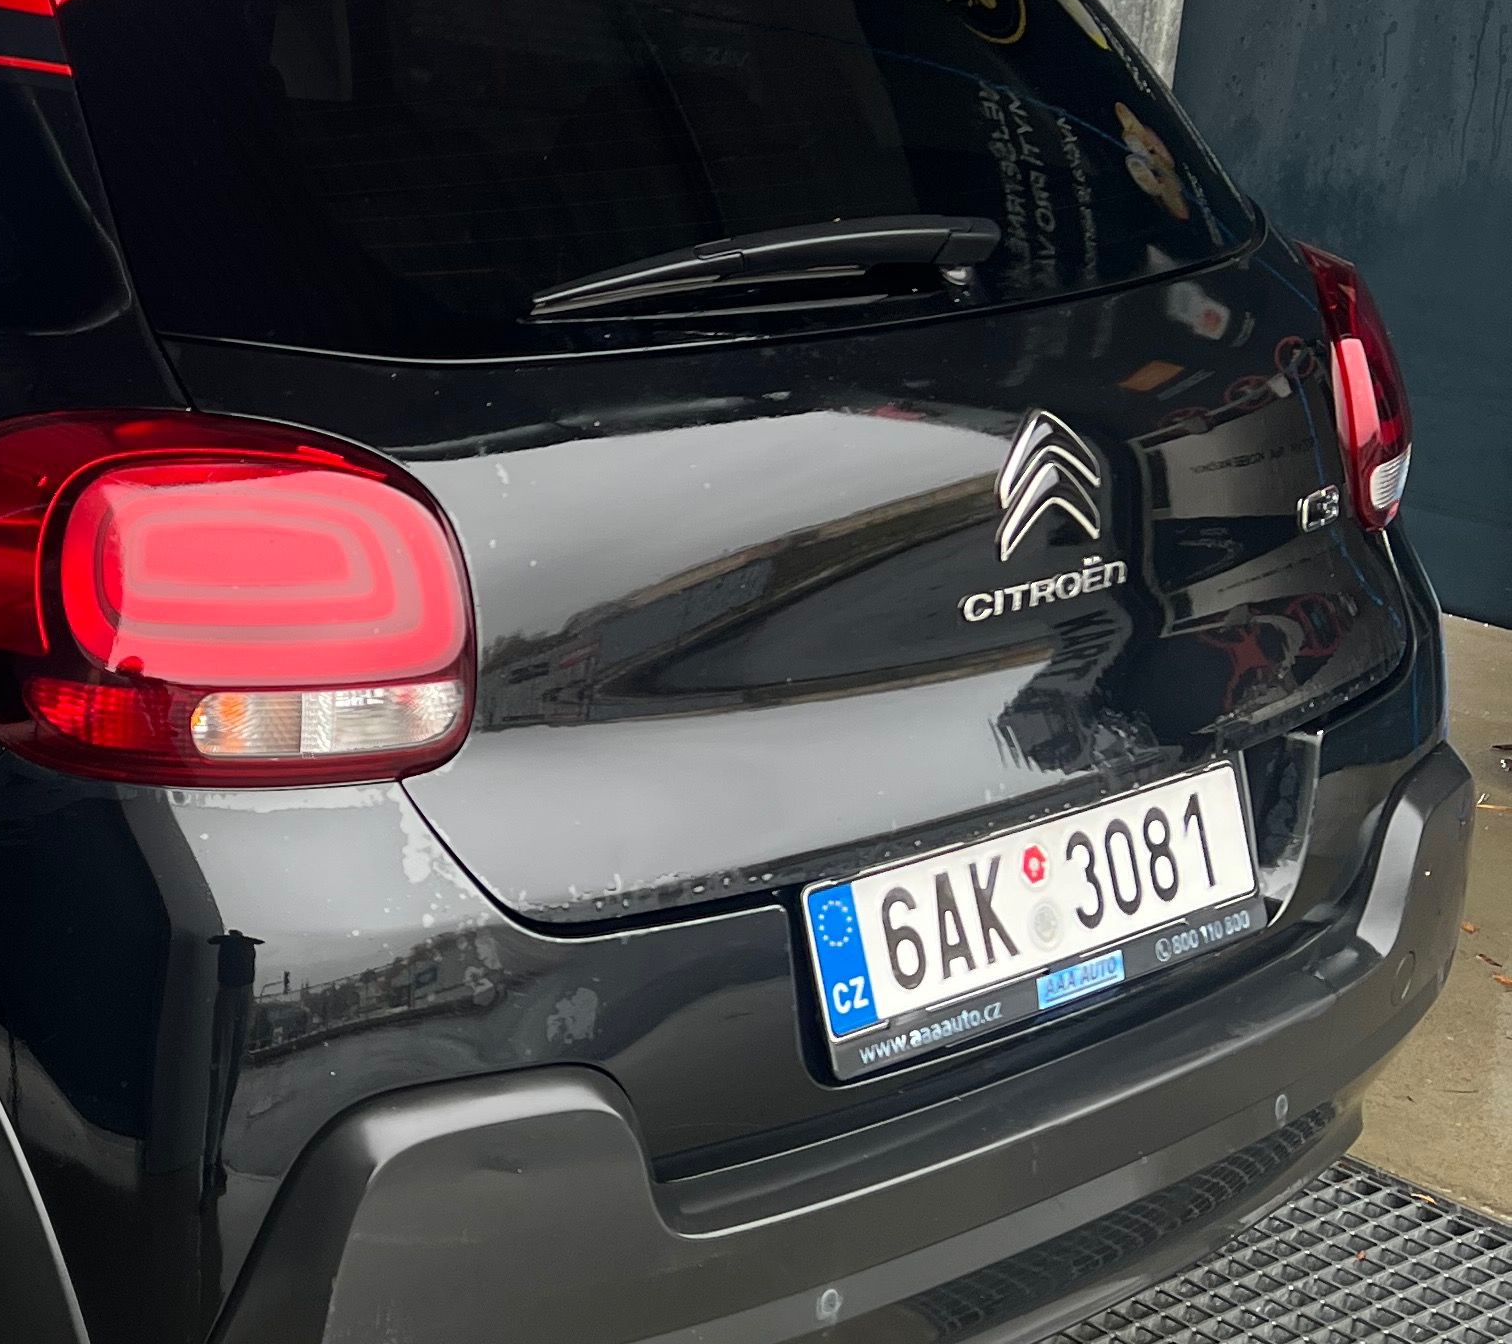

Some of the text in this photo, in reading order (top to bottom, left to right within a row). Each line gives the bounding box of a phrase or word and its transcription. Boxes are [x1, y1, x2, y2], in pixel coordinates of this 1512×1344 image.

[879, 790, 1218, 991] 6AK 3081
[1171, 929, 1200, 955] 800
[1199, 920, 1224, 944] 110
[1079, 956, 1118, 985] AUTO
[832, 973, 871, 1016] CZ
[858, 1000, 1005, 1066] www.aaaauto.cz
